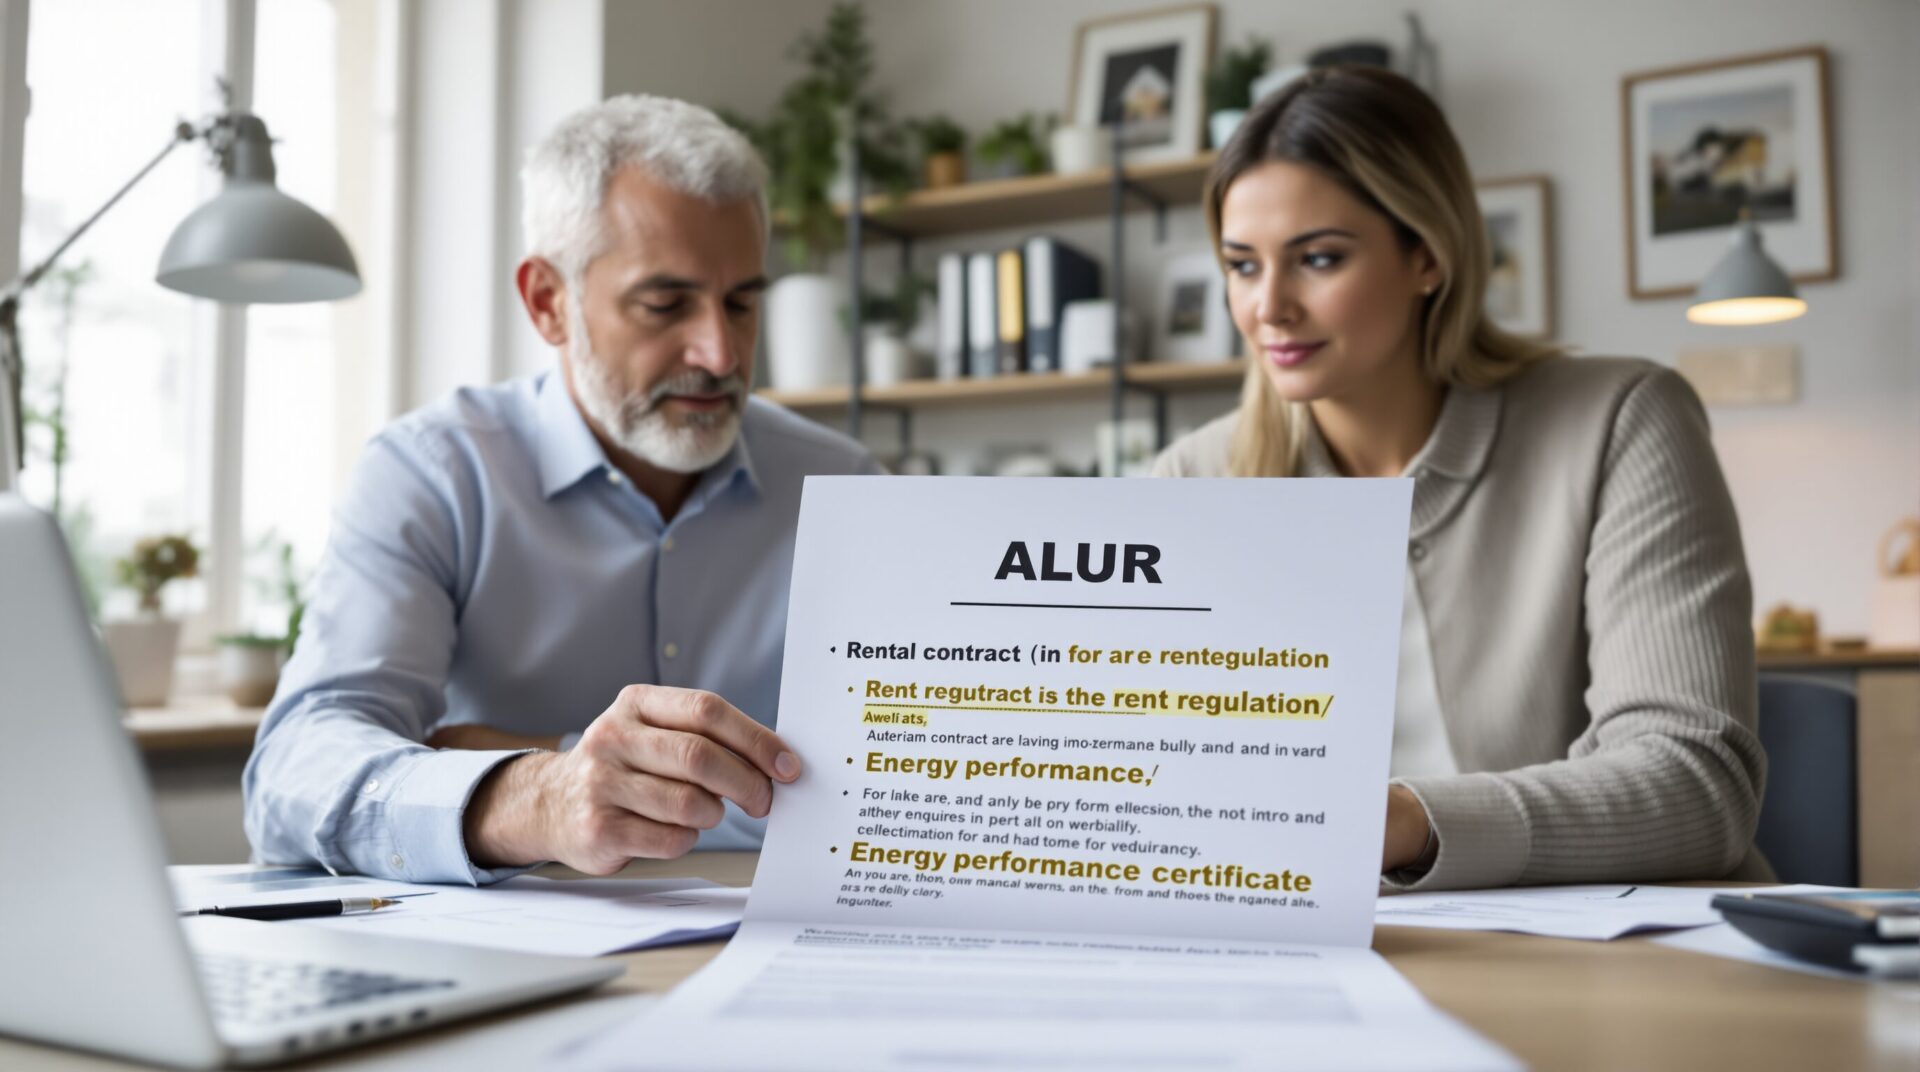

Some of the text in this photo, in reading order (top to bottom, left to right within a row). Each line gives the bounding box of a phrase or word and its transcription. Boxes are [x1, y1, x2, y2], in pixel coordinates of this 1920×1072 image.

[994, 541, 1163, 583] ALUR
[847, 642, 916, 660] Rental
[923, 645, 1021, 662] contract
[1031, 644, 1060, 665] (in
[1068, 644, 1102, 663] for
[1160, 647, 1329, 670] rentegulation
[866, 680, 1334, 717] Rent regutract is the rent regulation/
[867, 730, 926, 743] Auteriam
[931, 732, 987, 745] contract
[992, 736, 1014, 746] are
[1019, 735, 1059, 750] laving
[1160, 739, 1196, 755] bully
[1241, 743, 1270, 755] and
[1275, 744, 1288, 756] in
[866, 752, 958, 779] Energy
[863, 787, 886, 800] For
[925, 793, 950, 806] are,
[955, 794, 983, 806] and
[1025, 797, 1042, 810] be
[1047, 800, 1070, 813] pry
[1075, 798, 1109, 812] form
[1187, 805, 1213, 818] the
[1219, 807, 1246, 820] not
[1251, 808, 1289, 822] intro
[1295, 811, 1325, 824] and
[905, 810, 965, 823] enquires
[971, 812, 983, 824] in
[988, 814, 1019, 828] pert
[1024, 815, 1041, 828] all
[1046, 818, 1064, 829] on
[958, 830, 977, 842] for
[982, 832, 1009, 844] and
[1013, 834, 1039, 847] had
[1043, 836, 1080, 849] tome
[1085, 838, 1106, 851] for
[850, 841, 1312, 892] Energy performance certificate
[844, 868, 862, 878] An
[865, 871, 887, 880] you
[1115, 885, 1143, 897] from
[1147, 889, 1170, 899] and
[1215, 892, 1235, 902] the
